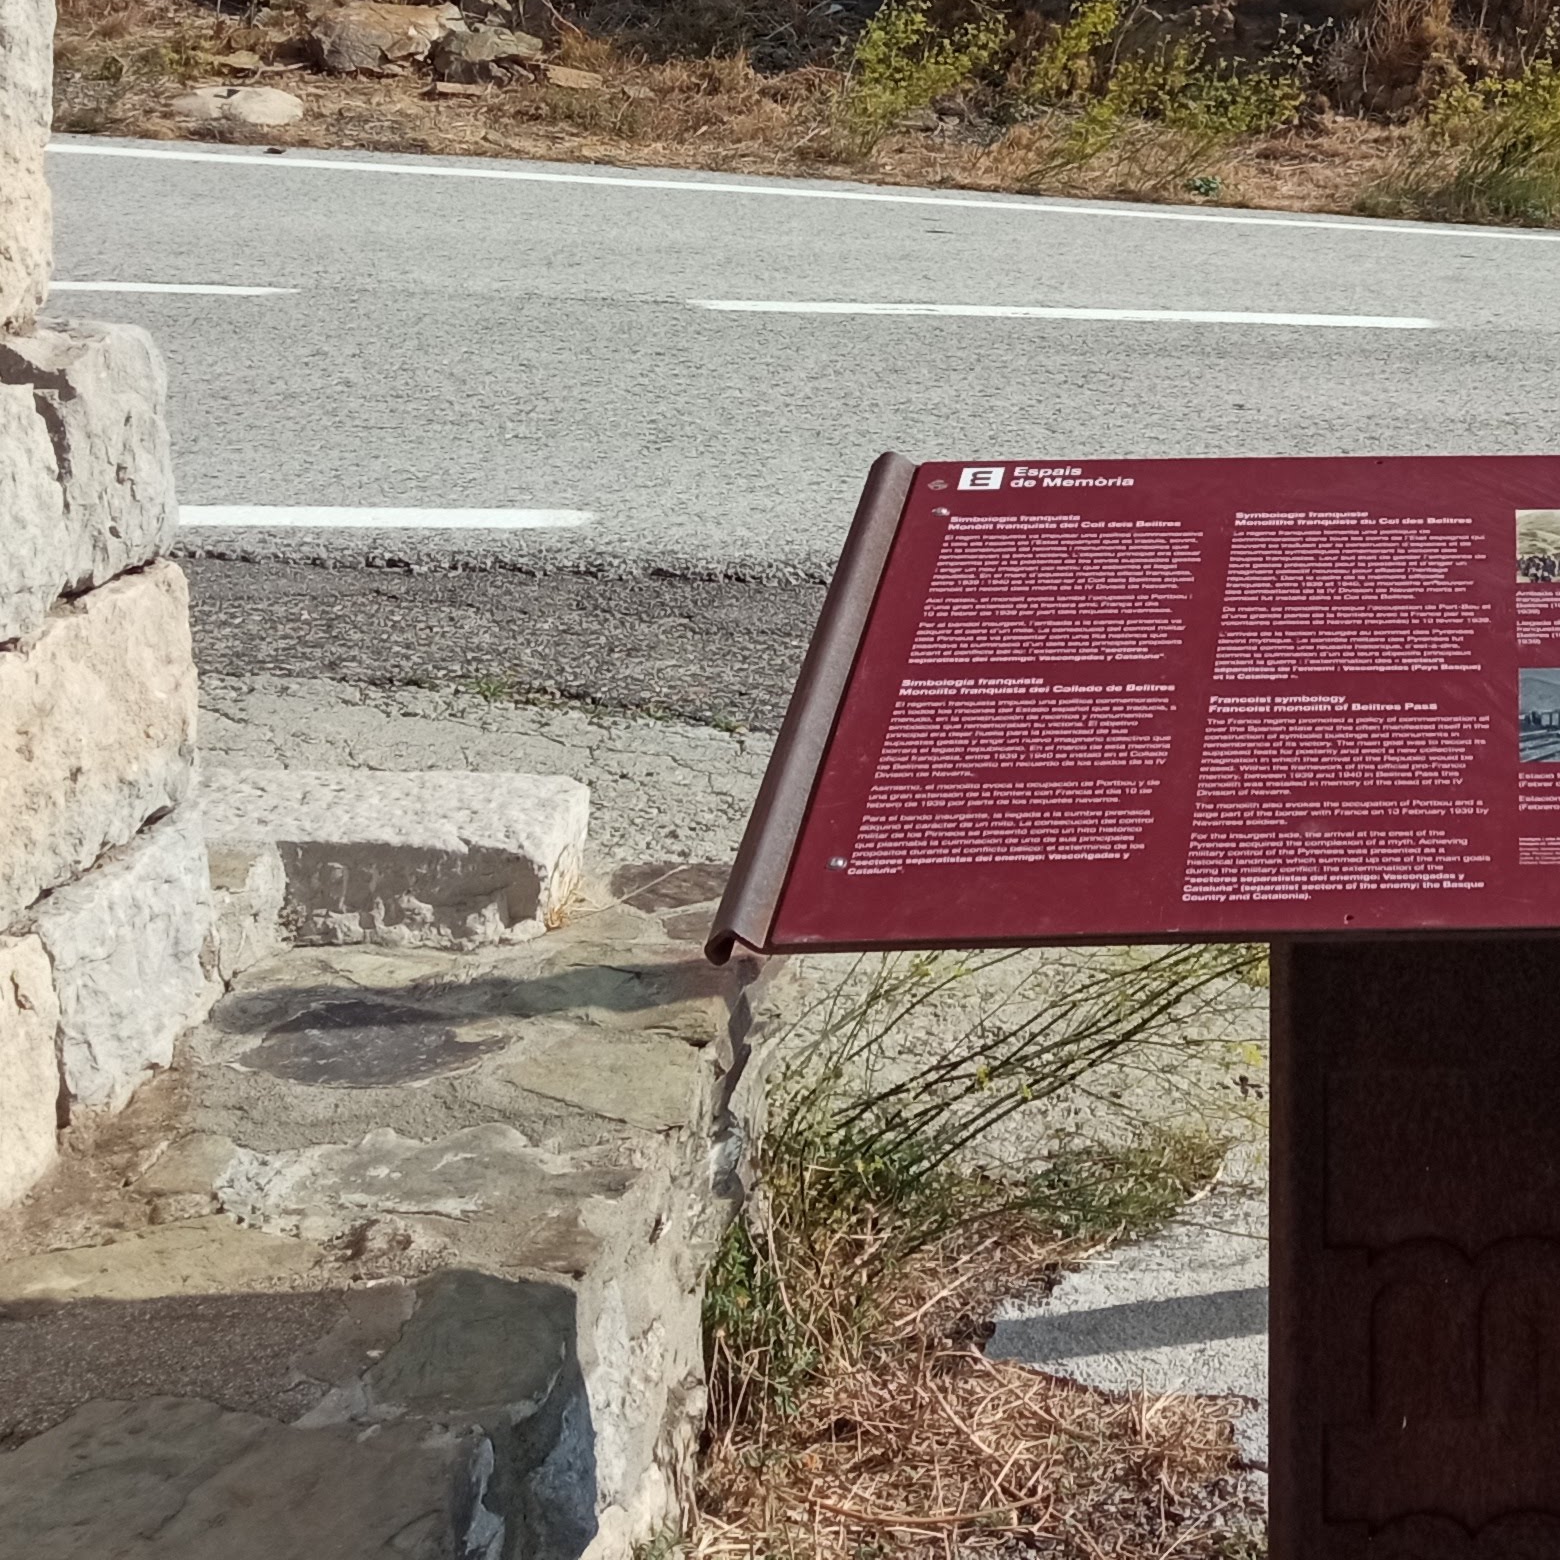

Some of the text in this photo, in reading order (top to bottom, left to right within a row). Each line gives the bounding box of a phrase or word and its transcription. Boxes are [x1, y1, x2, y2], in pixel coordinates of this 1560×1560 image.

[1013, 466, 1082, 478] Espais
[1010, 476, 1134, 488] de Memòria
